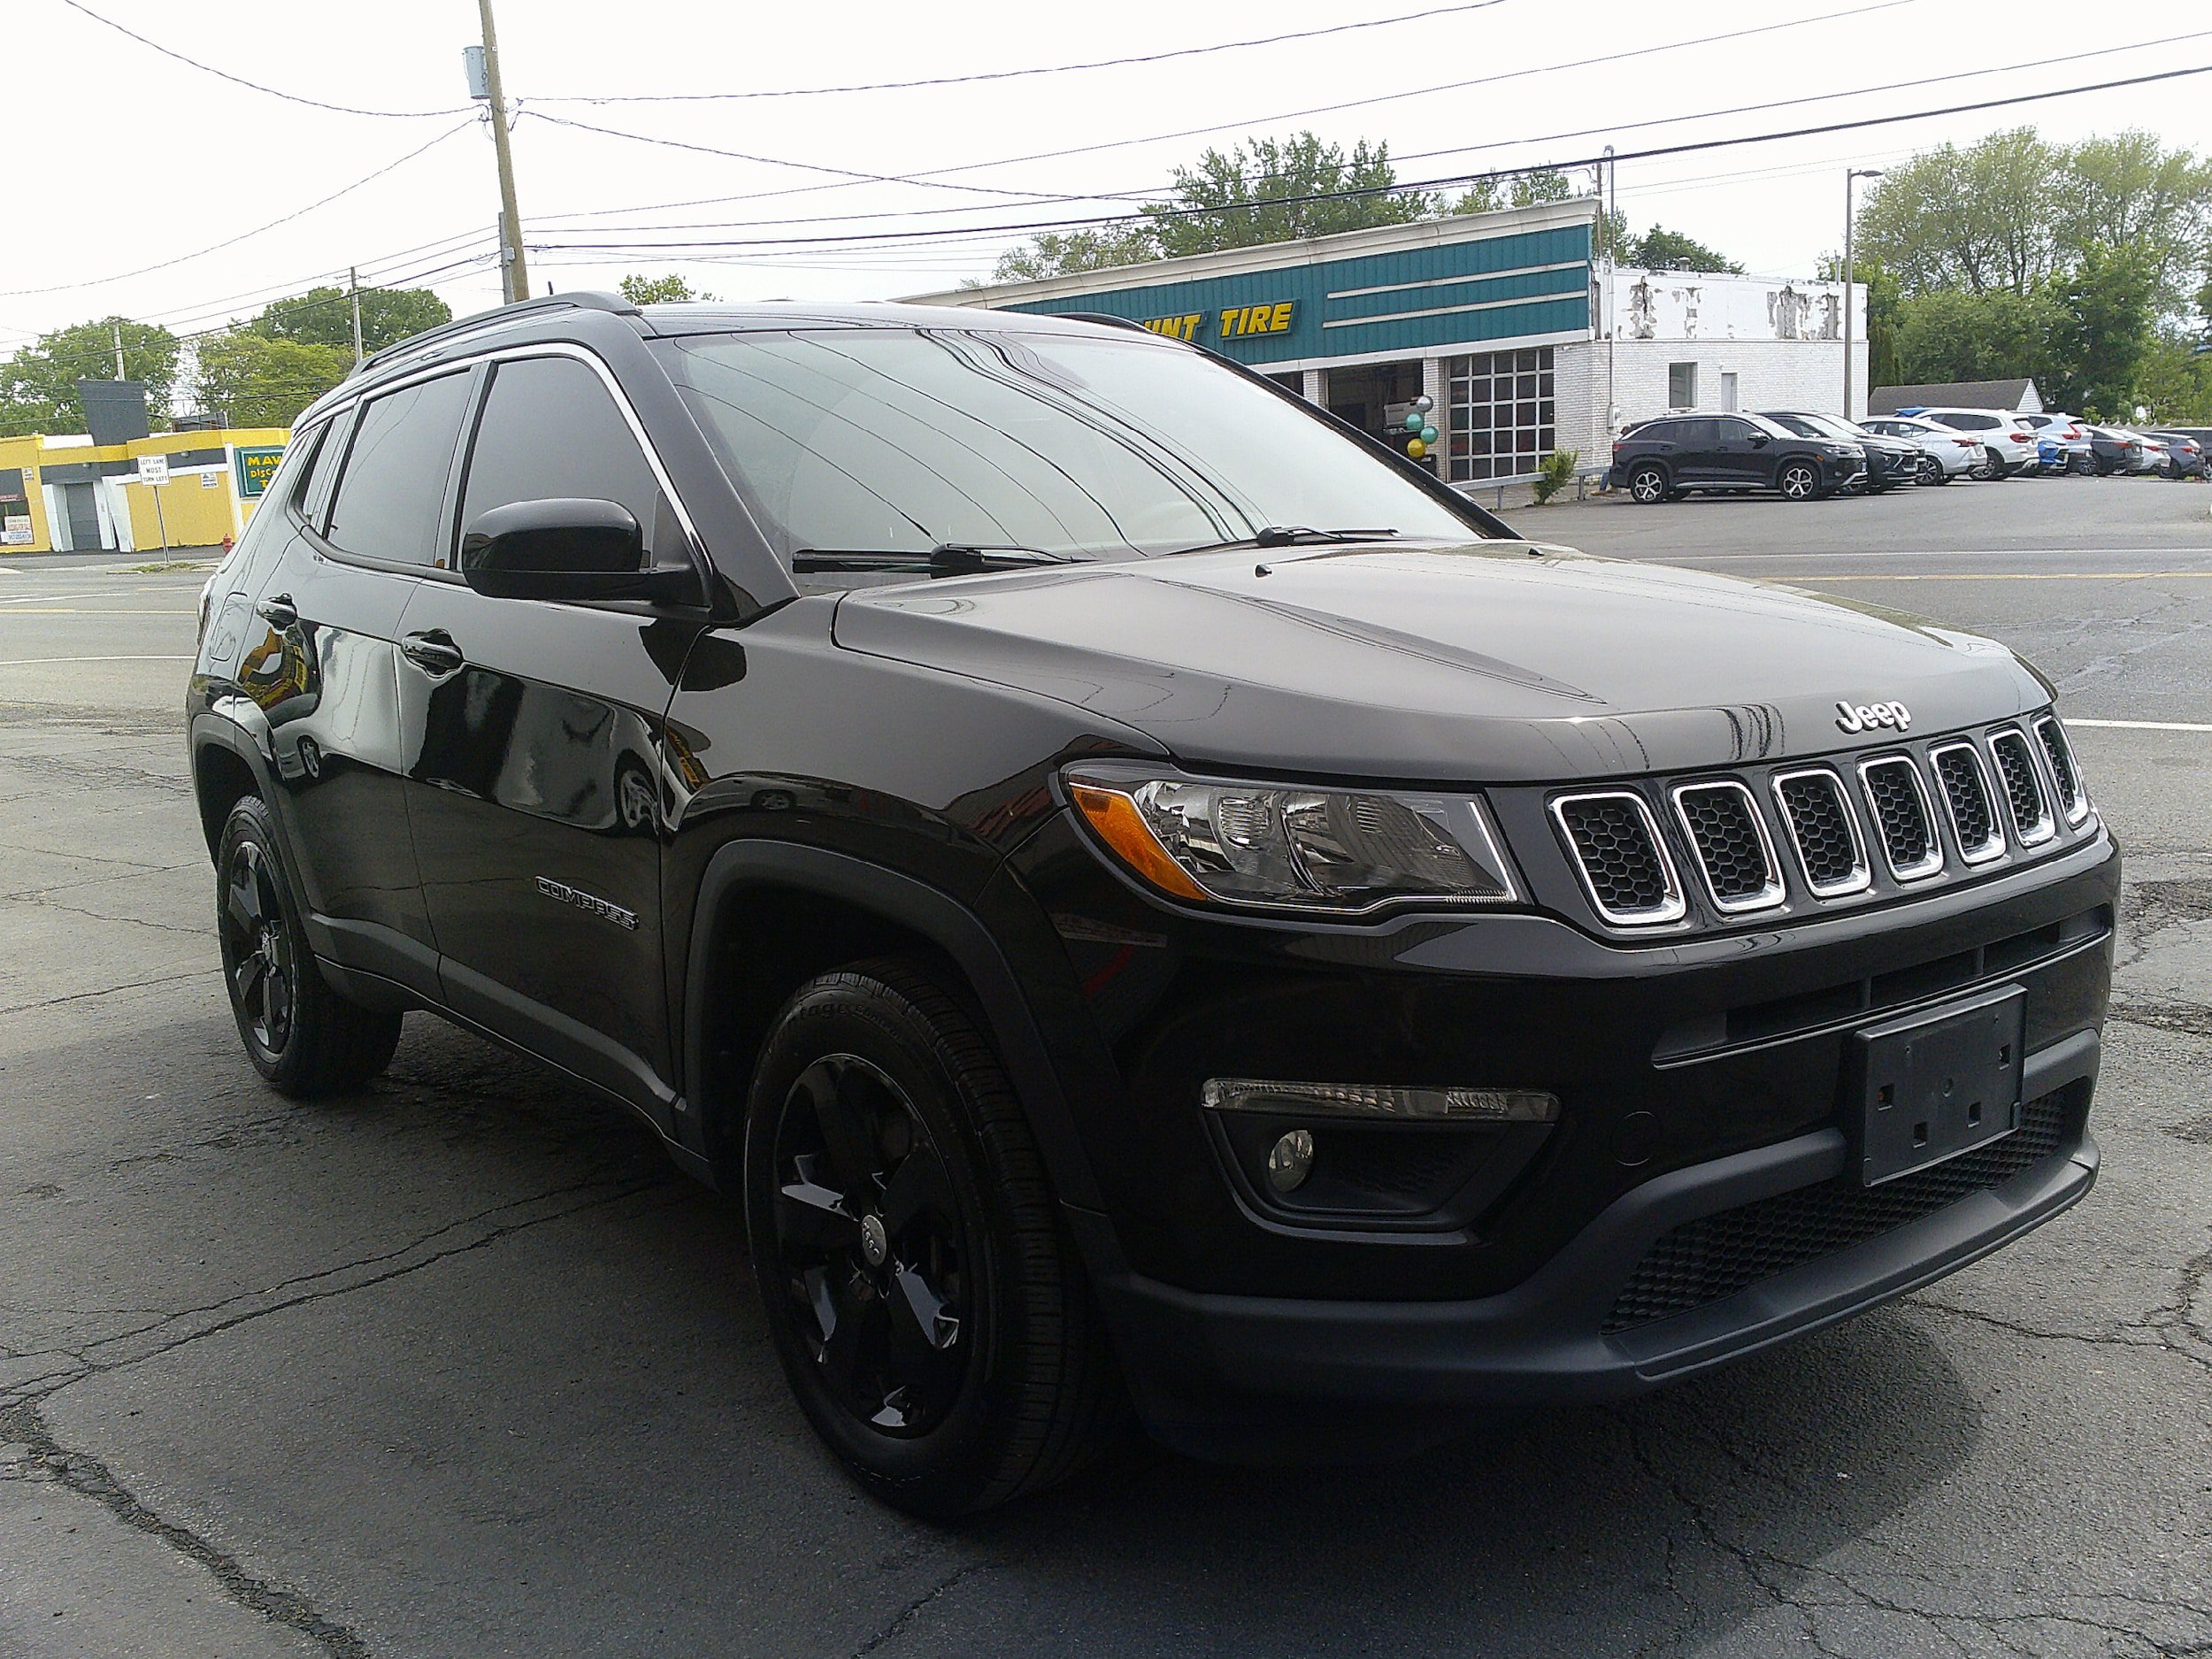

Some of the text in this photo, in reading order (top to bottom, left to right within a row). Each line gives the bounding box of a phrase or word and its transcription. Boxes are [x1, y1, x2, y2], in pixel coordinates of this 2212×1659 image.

[1220, 302, 1293, 337] TIRE
[1835, 700, 1913, 735] Jeep
[534, 874, 640, 931] COMPASS
